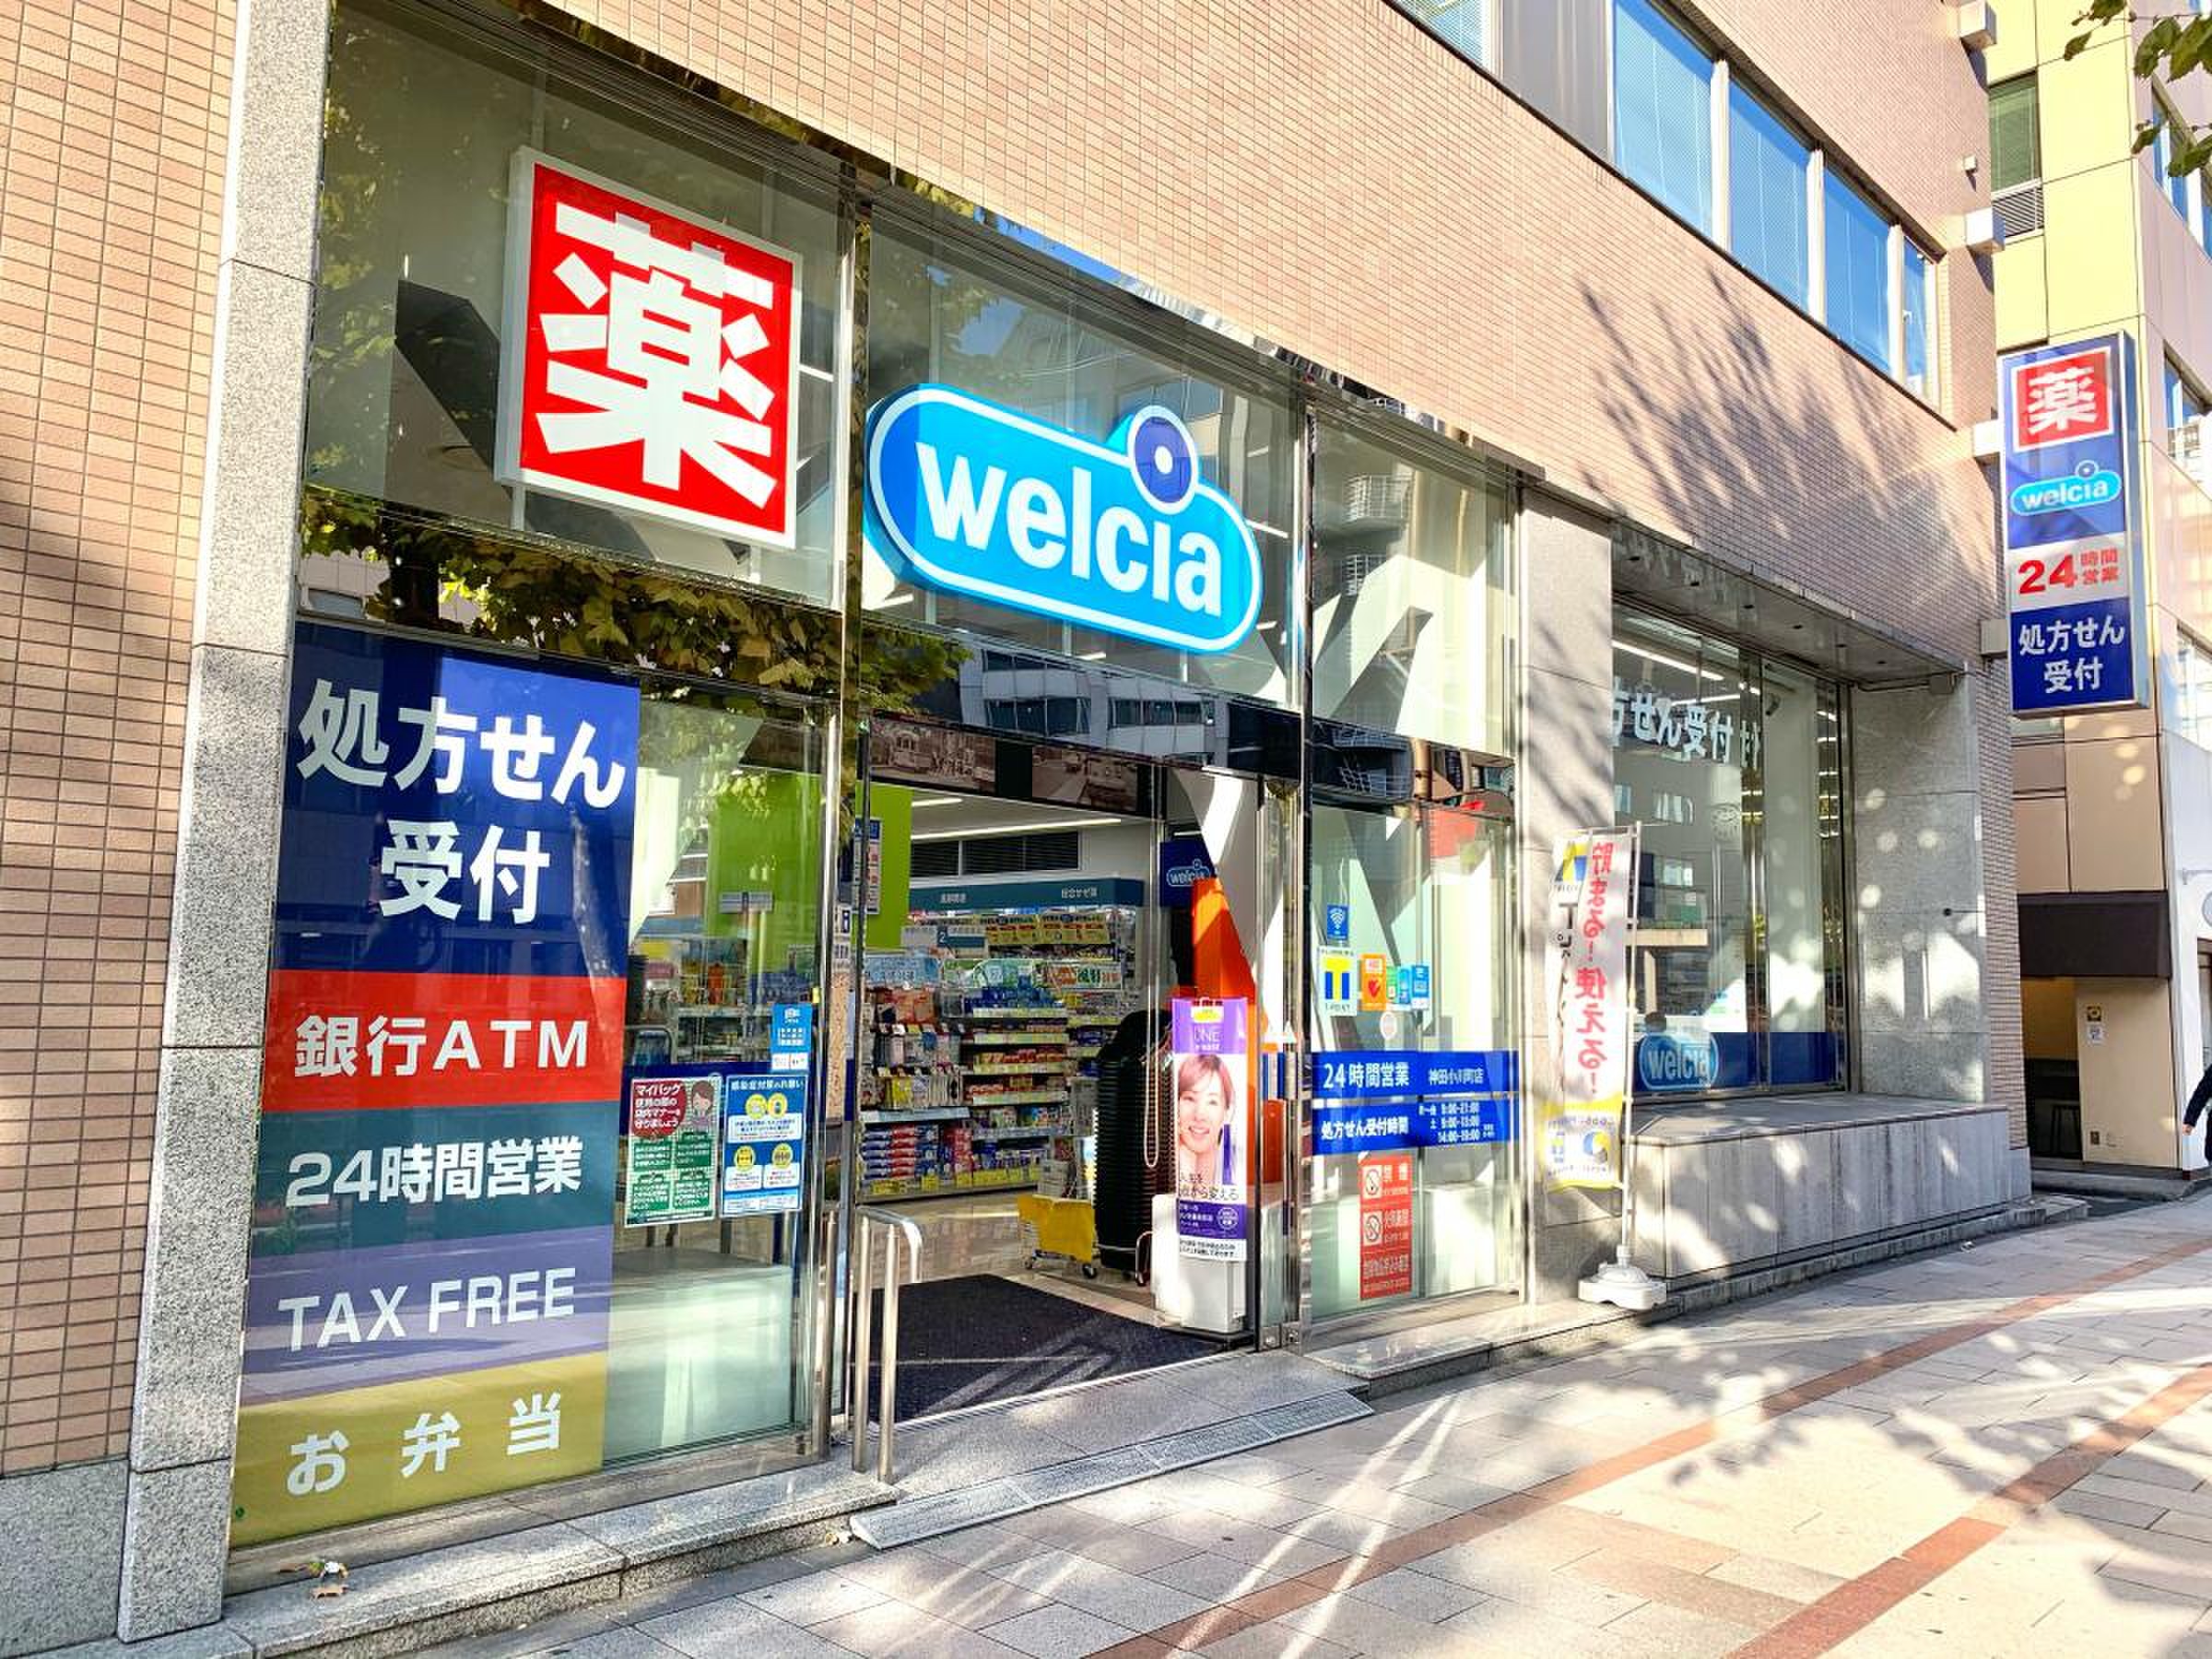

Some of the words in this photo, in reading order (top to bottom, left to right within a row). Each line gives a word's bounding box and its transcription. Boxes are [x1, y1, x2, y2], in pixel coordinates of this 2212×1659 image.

[535, 202, 777, 509] 薬
[2027, 366, 2098, 437] 薬
[915, 406, 1223, 618] welcia
[2020, 460, 2110, 509] welcia
[2018, 554, 2079, 595] 24
[2018, 615, 2124, 656] 処方せん
[2043, 657, 2104, 694] 受付
[297, 677, 626, 807] 処方せん
[379, 818, 550, 924] 受付
[294, 1015, 588, 1077] 銀行ATM
[1321, 1116, 1409, 1140] 処方せん受付時間
[285, 1135, 583, 1207] 24時間営業
[278, 1285, 408, 1352] TAX
[428, 1267, 576, 1334] FREE
[287, 1392, 562, 1495] お弁当
